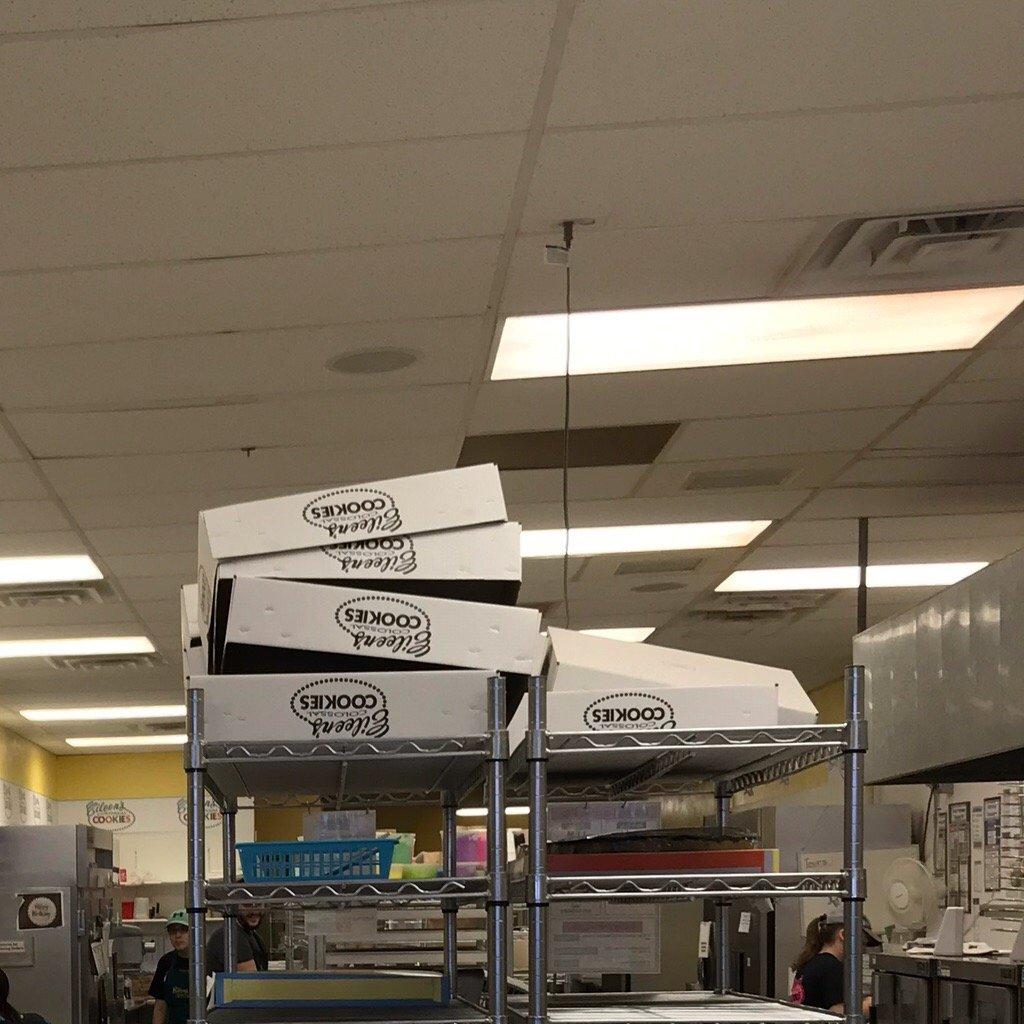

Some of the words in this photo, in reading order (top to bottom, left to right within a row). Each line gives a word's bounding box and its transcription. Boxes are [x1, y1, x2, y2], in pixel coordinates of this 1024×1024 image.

[311, 498, 386, 519] COOKIES
[323, 508, 402, 539] Eileen's
[337, 550, 417, 575] Eileen's
[345, 608, 421, 629] COOKIES
[351, 630, 432, 657] Eileen's
[300, 694, 377, 710] COOKIES
[308, 709, 389, 738] Eileen's
[592, 707, 665, 722] COOKIES
[92, 815, 131, 824] COOKIES
